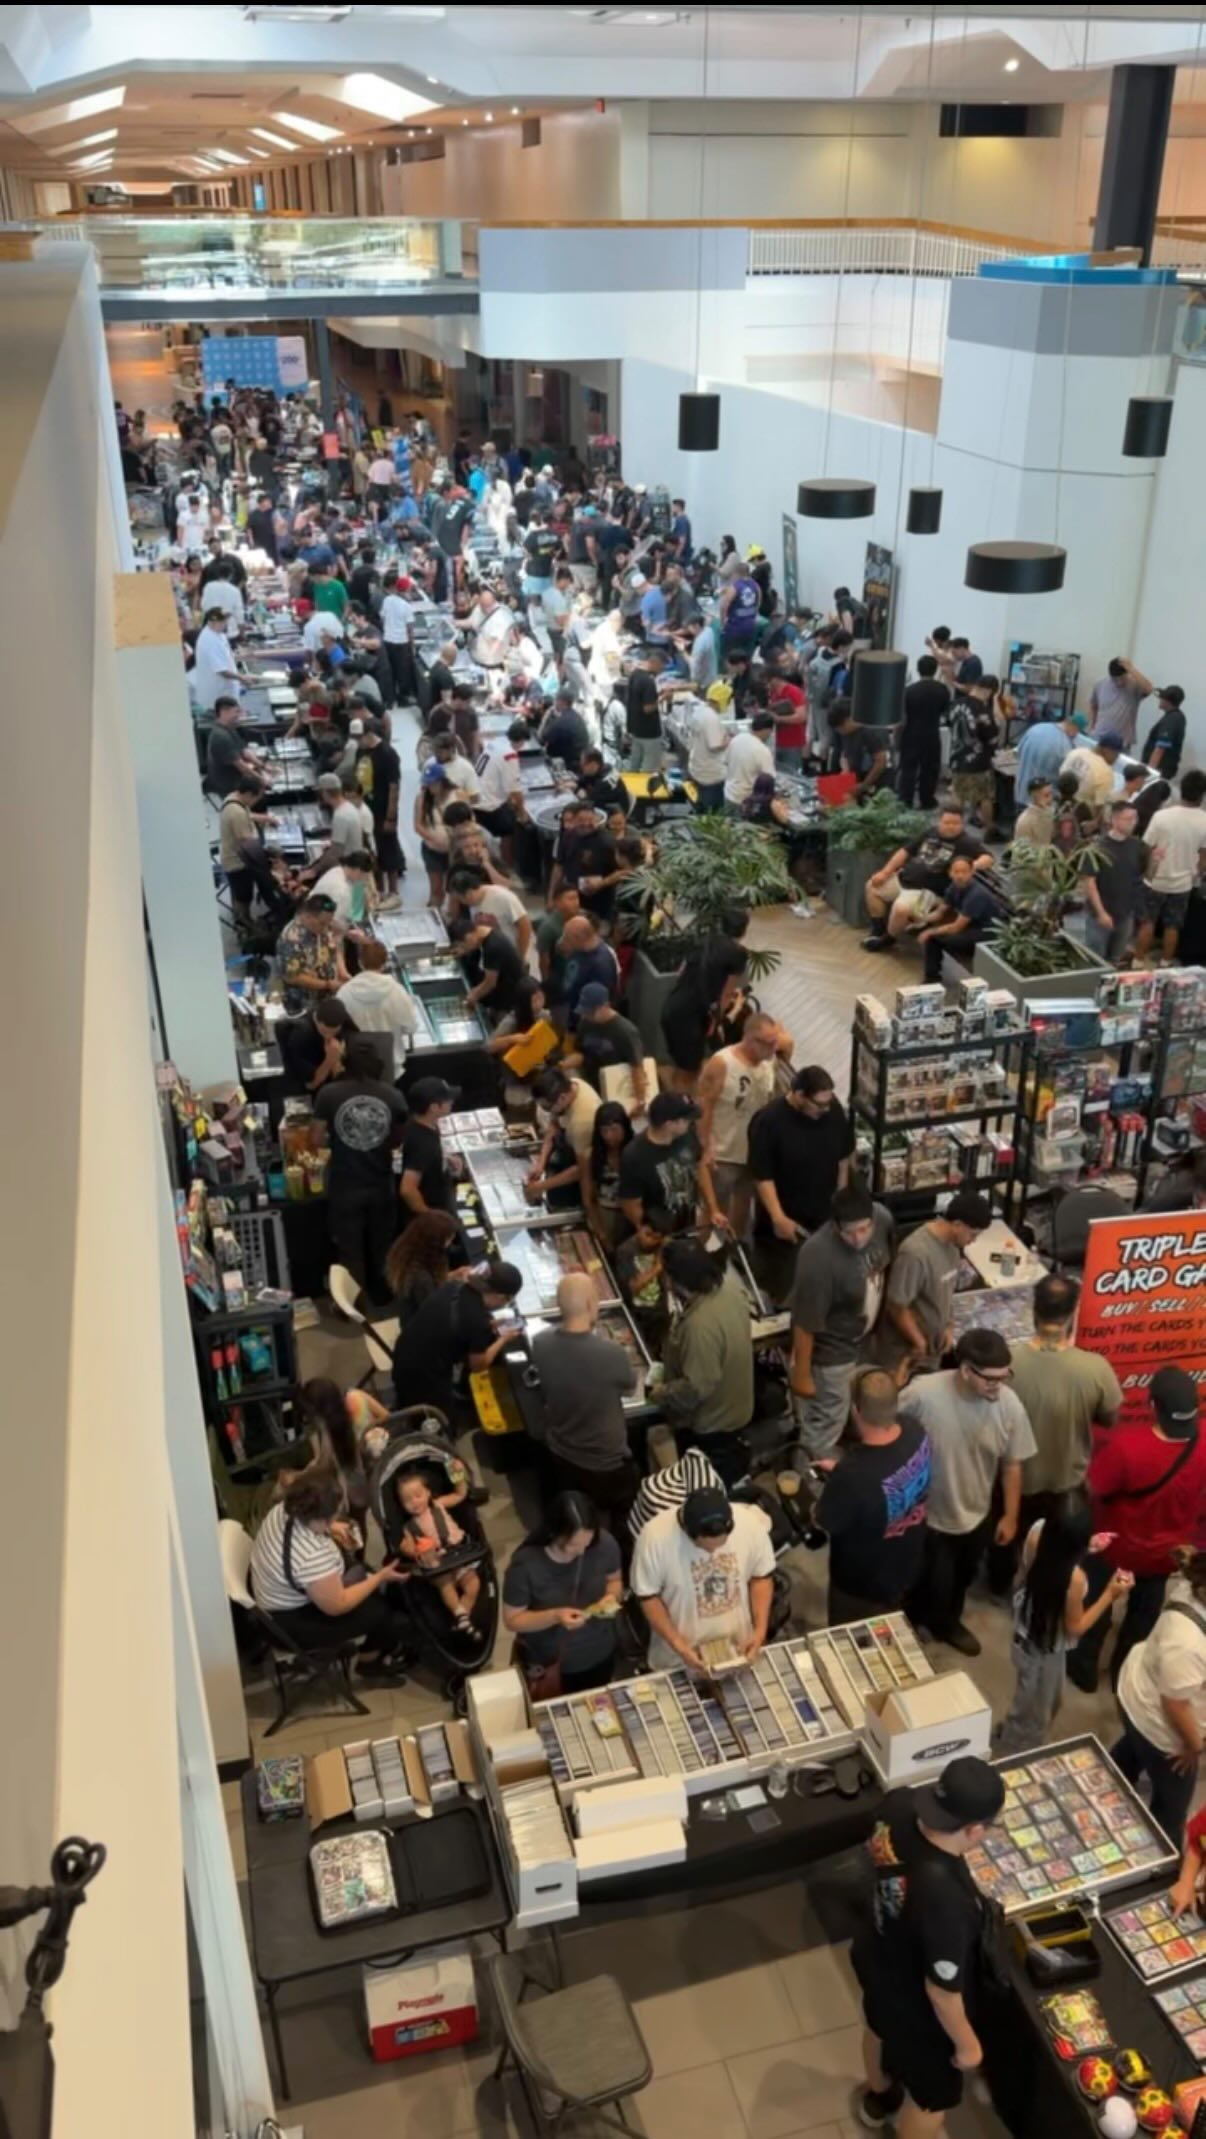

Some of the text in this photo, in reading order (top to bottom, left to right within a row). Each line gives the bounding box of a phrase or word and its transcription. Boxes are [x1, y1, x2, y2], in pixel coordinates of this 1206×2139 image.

[1119, 1231, 1206, 1264] TRIPLE
[1095, 1265, 1169, 1294] CARD
[1100, 1301, 1138, 1318] BUY
[1149, 1297, 1187, 1314] SELL
[1081, 1326, 1115, 1338] TURN
[1119, 1321, 1145, 1334] THE
[1148, 1318, 1194, 1332] CARDS
[1114, 1342, 1138, 1354] THE
[1142, 1338, 1188, 1352] CARDS
